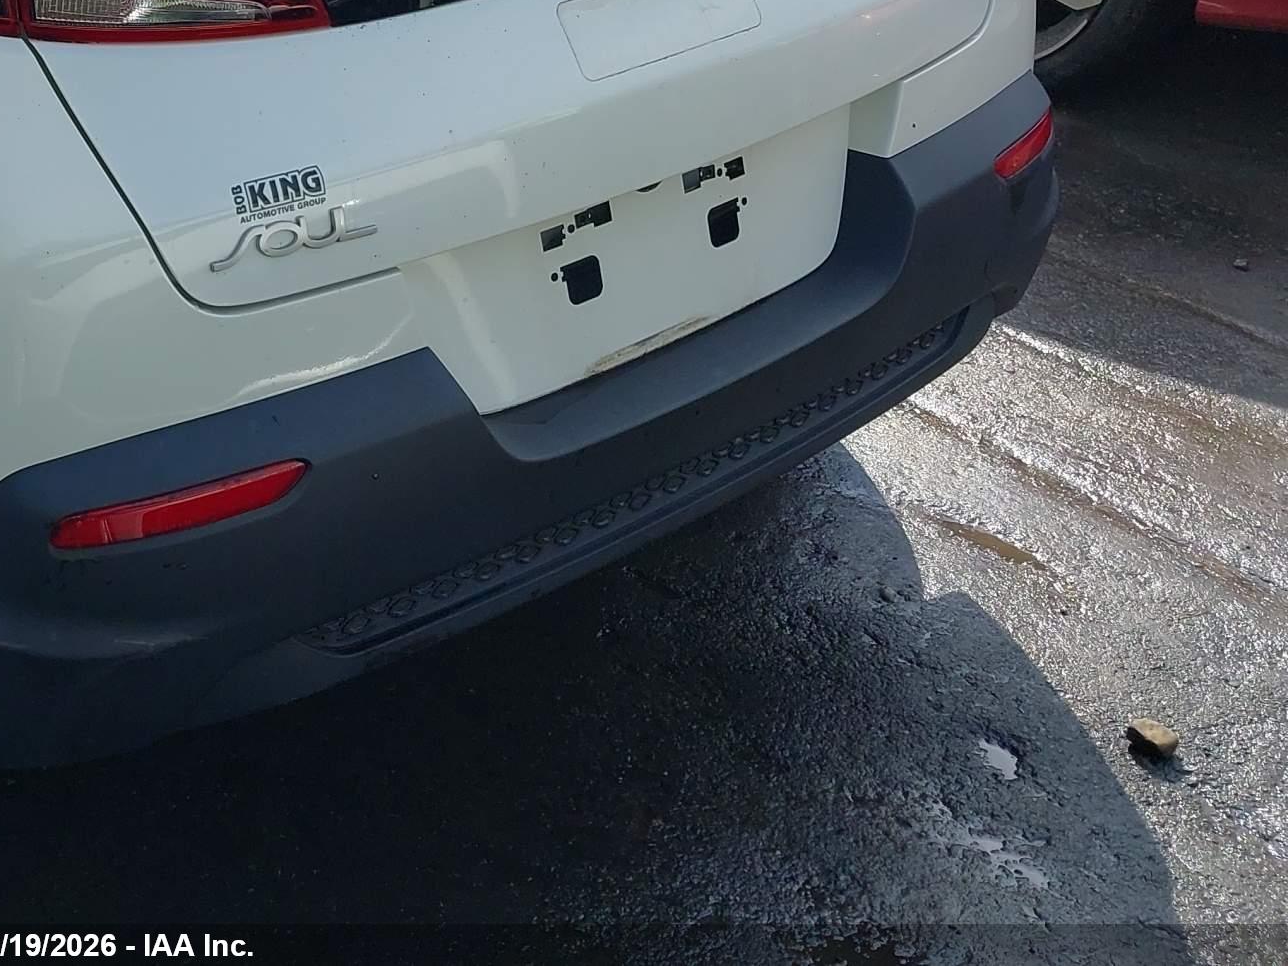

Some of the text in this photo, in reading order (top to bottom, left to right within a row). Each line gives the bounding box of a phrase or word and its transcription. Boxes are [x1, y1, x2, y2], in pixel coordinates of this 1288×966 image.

[231, 184, 247, 215] BOB
[246, 170, 323, 209] KING
[240, 197, 326, 224] AUTOMOTIVE GROUP
[209, 206, 378, 272] SOUL
